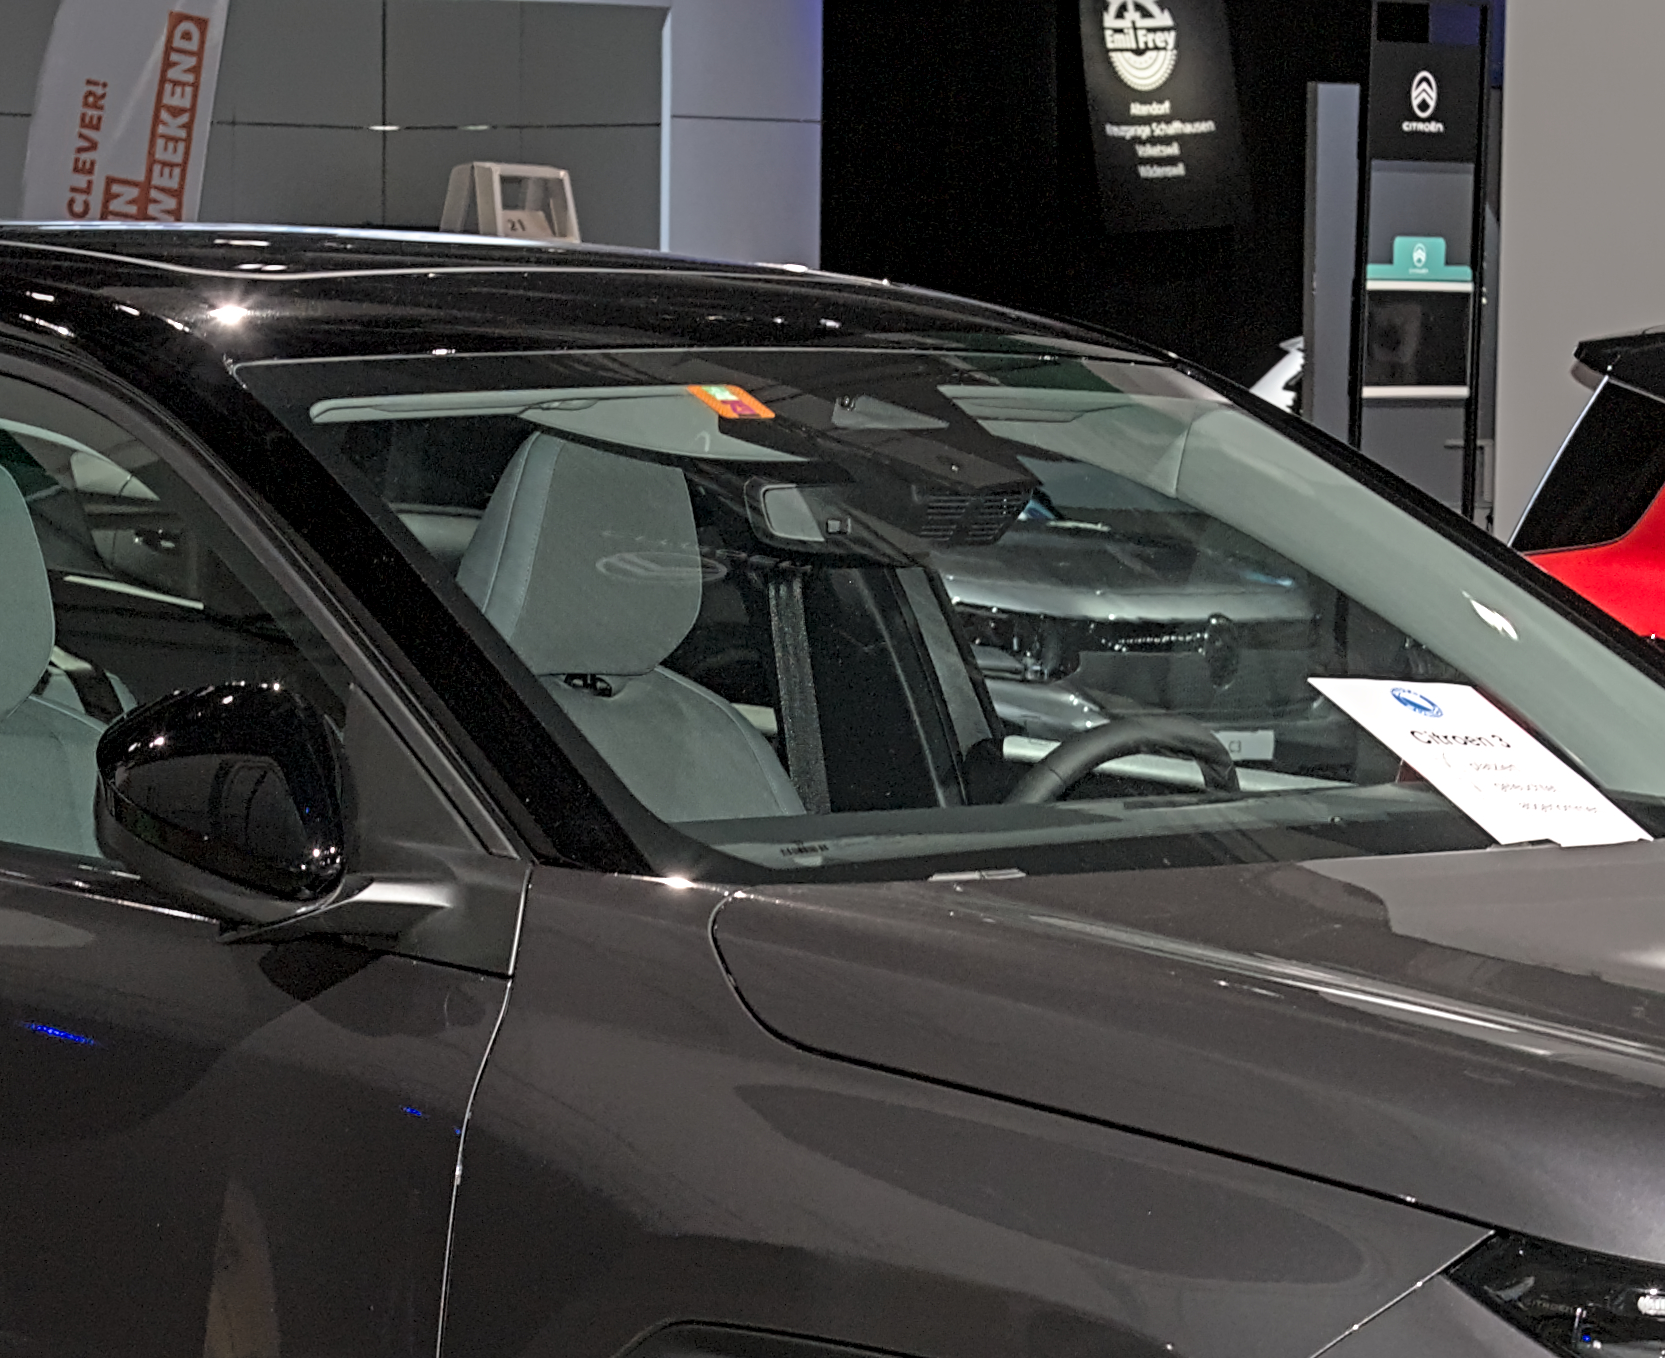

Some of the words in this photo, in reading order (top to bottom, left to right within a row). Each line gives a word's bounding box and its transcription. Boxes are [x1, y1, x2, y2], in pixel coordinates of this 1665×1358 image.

[1104, 28, 1136, 49] Emil
[1136, 28, 1177, 51] Frey
[67, 78, 108, 219] CLEVER!
[147, 20, 200, 221] WEEKEND
